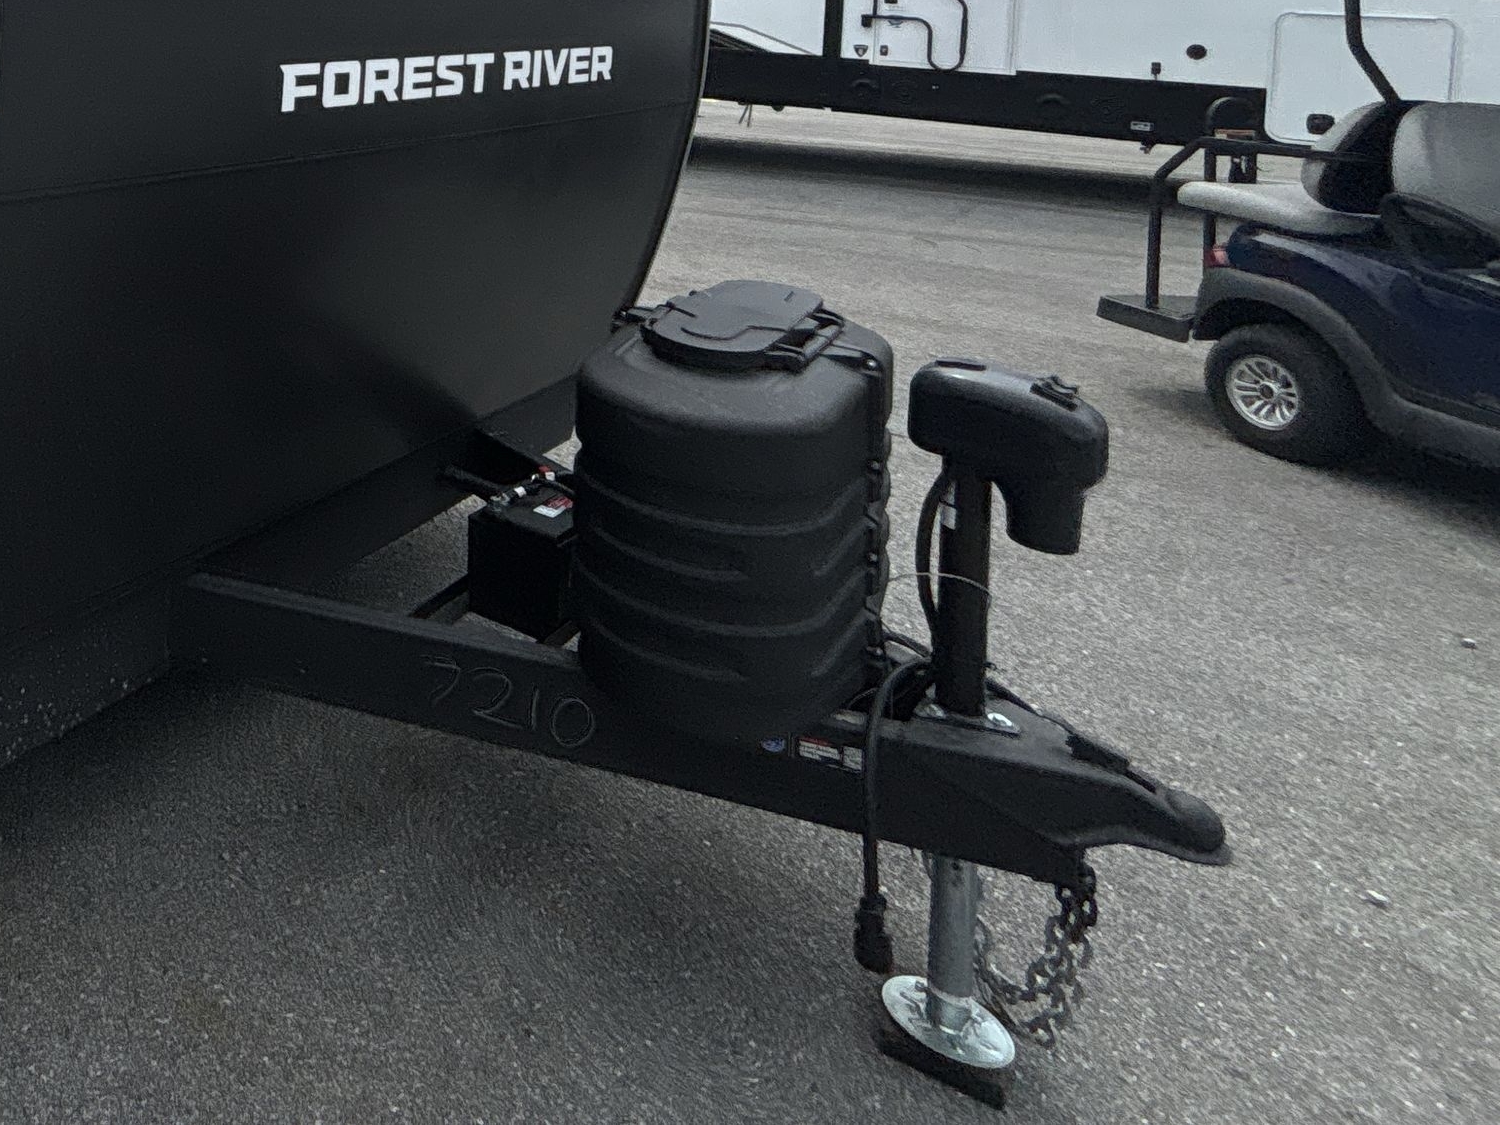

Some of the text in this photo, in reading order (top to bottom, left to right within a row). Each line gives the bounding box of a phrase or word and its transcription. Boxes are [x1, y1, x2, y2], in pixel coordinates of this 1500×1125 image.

[279, 45, 613, 113] FOREST RIVER
[419, 654, 596, 748] 7210
